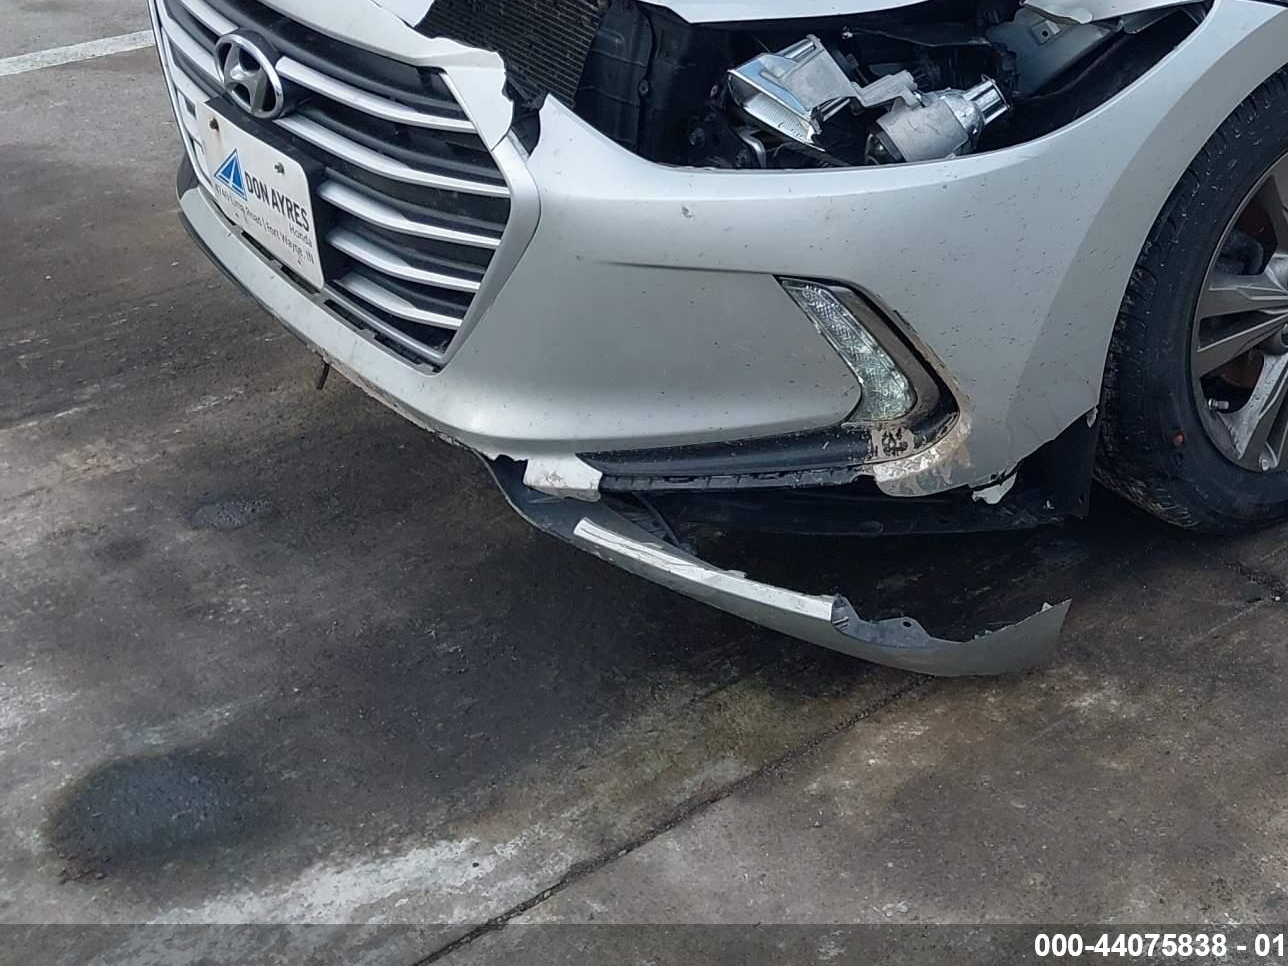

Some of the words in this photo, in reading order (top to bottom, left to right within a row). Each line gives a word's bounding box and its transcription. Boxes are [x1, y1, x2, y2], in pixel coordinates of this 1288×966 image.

[245, 171, 270, 206] DON
[271, 188, 309, 232] AYRES
[289, 223, 313, 248] Honda
